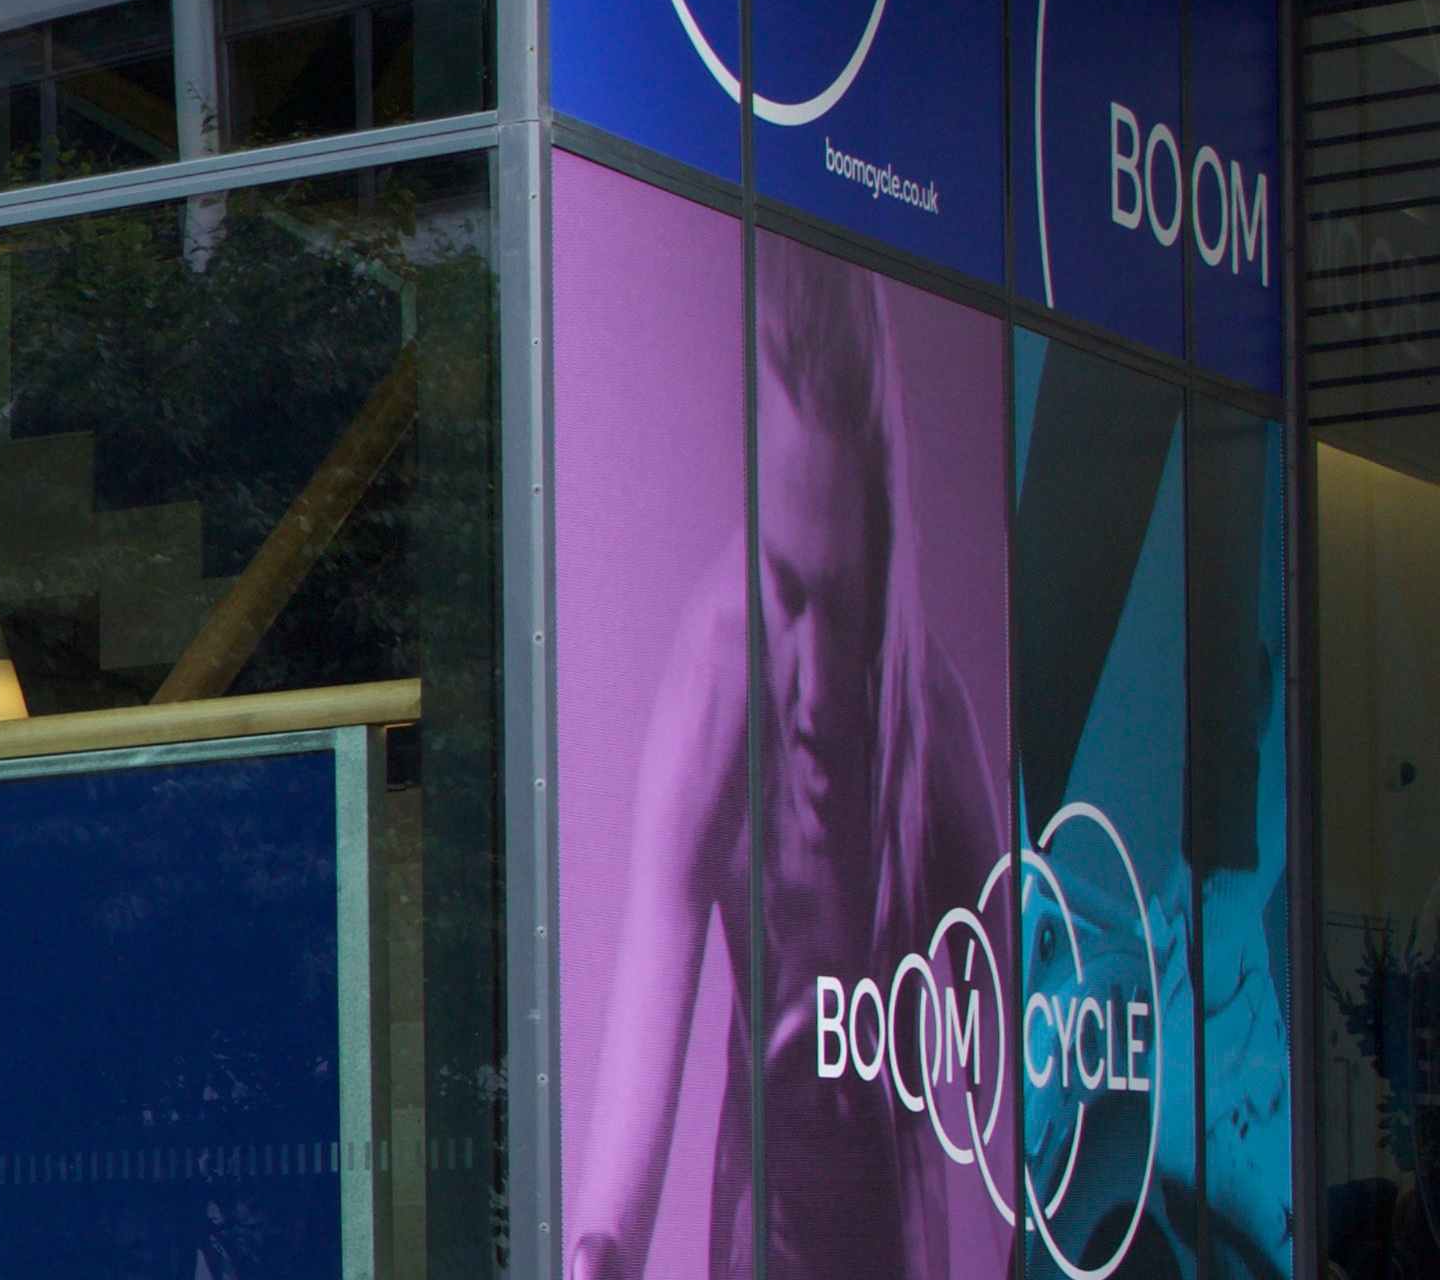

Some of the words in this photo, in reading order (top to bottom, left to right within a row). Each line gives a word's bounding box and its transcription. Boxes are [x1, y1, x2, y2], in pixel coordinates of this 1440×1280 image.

[825, 135, 940, 215] boomcycle.co.uk
[1110, 101, 1268, 288] BOOM
[816, 954, 981, 1111] BOOM
[1023, 992, 1150, 1092] CYCLE
